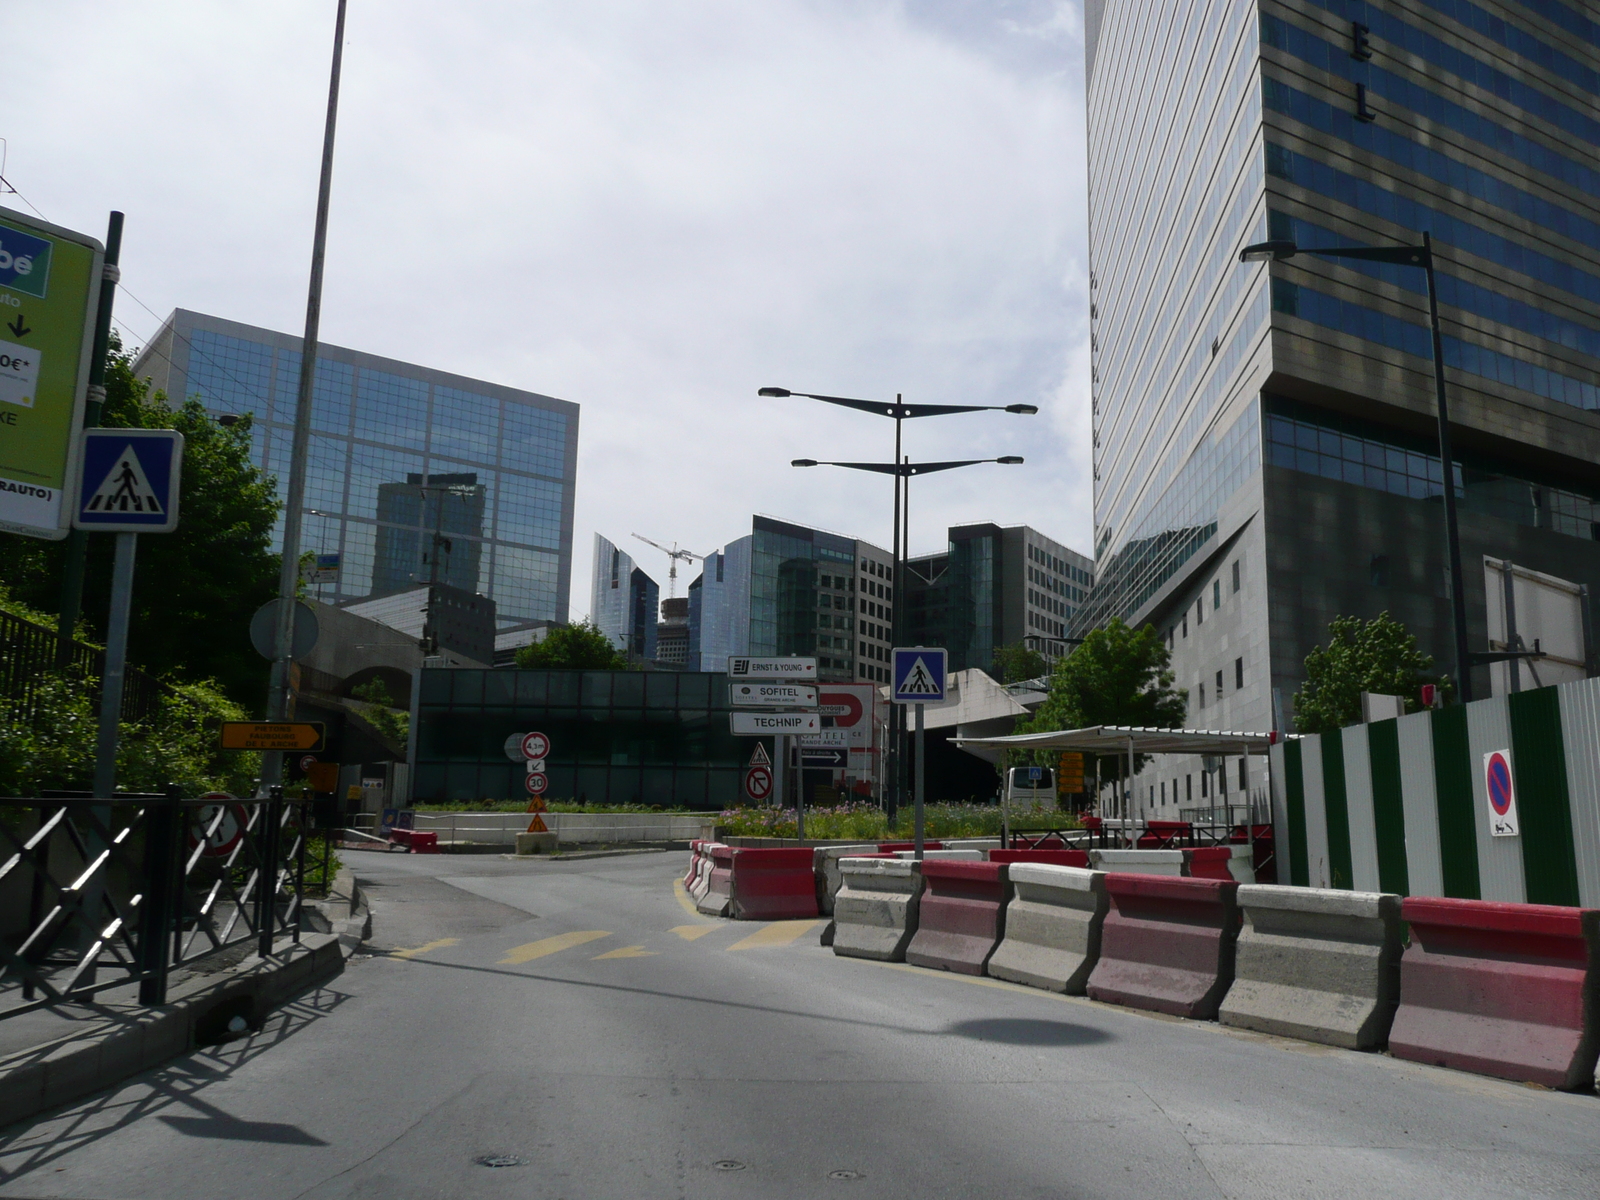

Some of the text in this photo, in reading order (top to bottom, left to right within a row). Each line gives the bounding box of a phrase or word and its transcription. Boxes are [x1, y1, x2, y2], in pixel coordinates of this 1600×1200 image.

[752, 663, 772, 671] ERNST
[779, 663, 803, 672] YOUNG
[759, 687, 799, 697] SOFITEL
[753, 717, 802, 727] TECHNIP
[530, 778, 543, 788] 30
